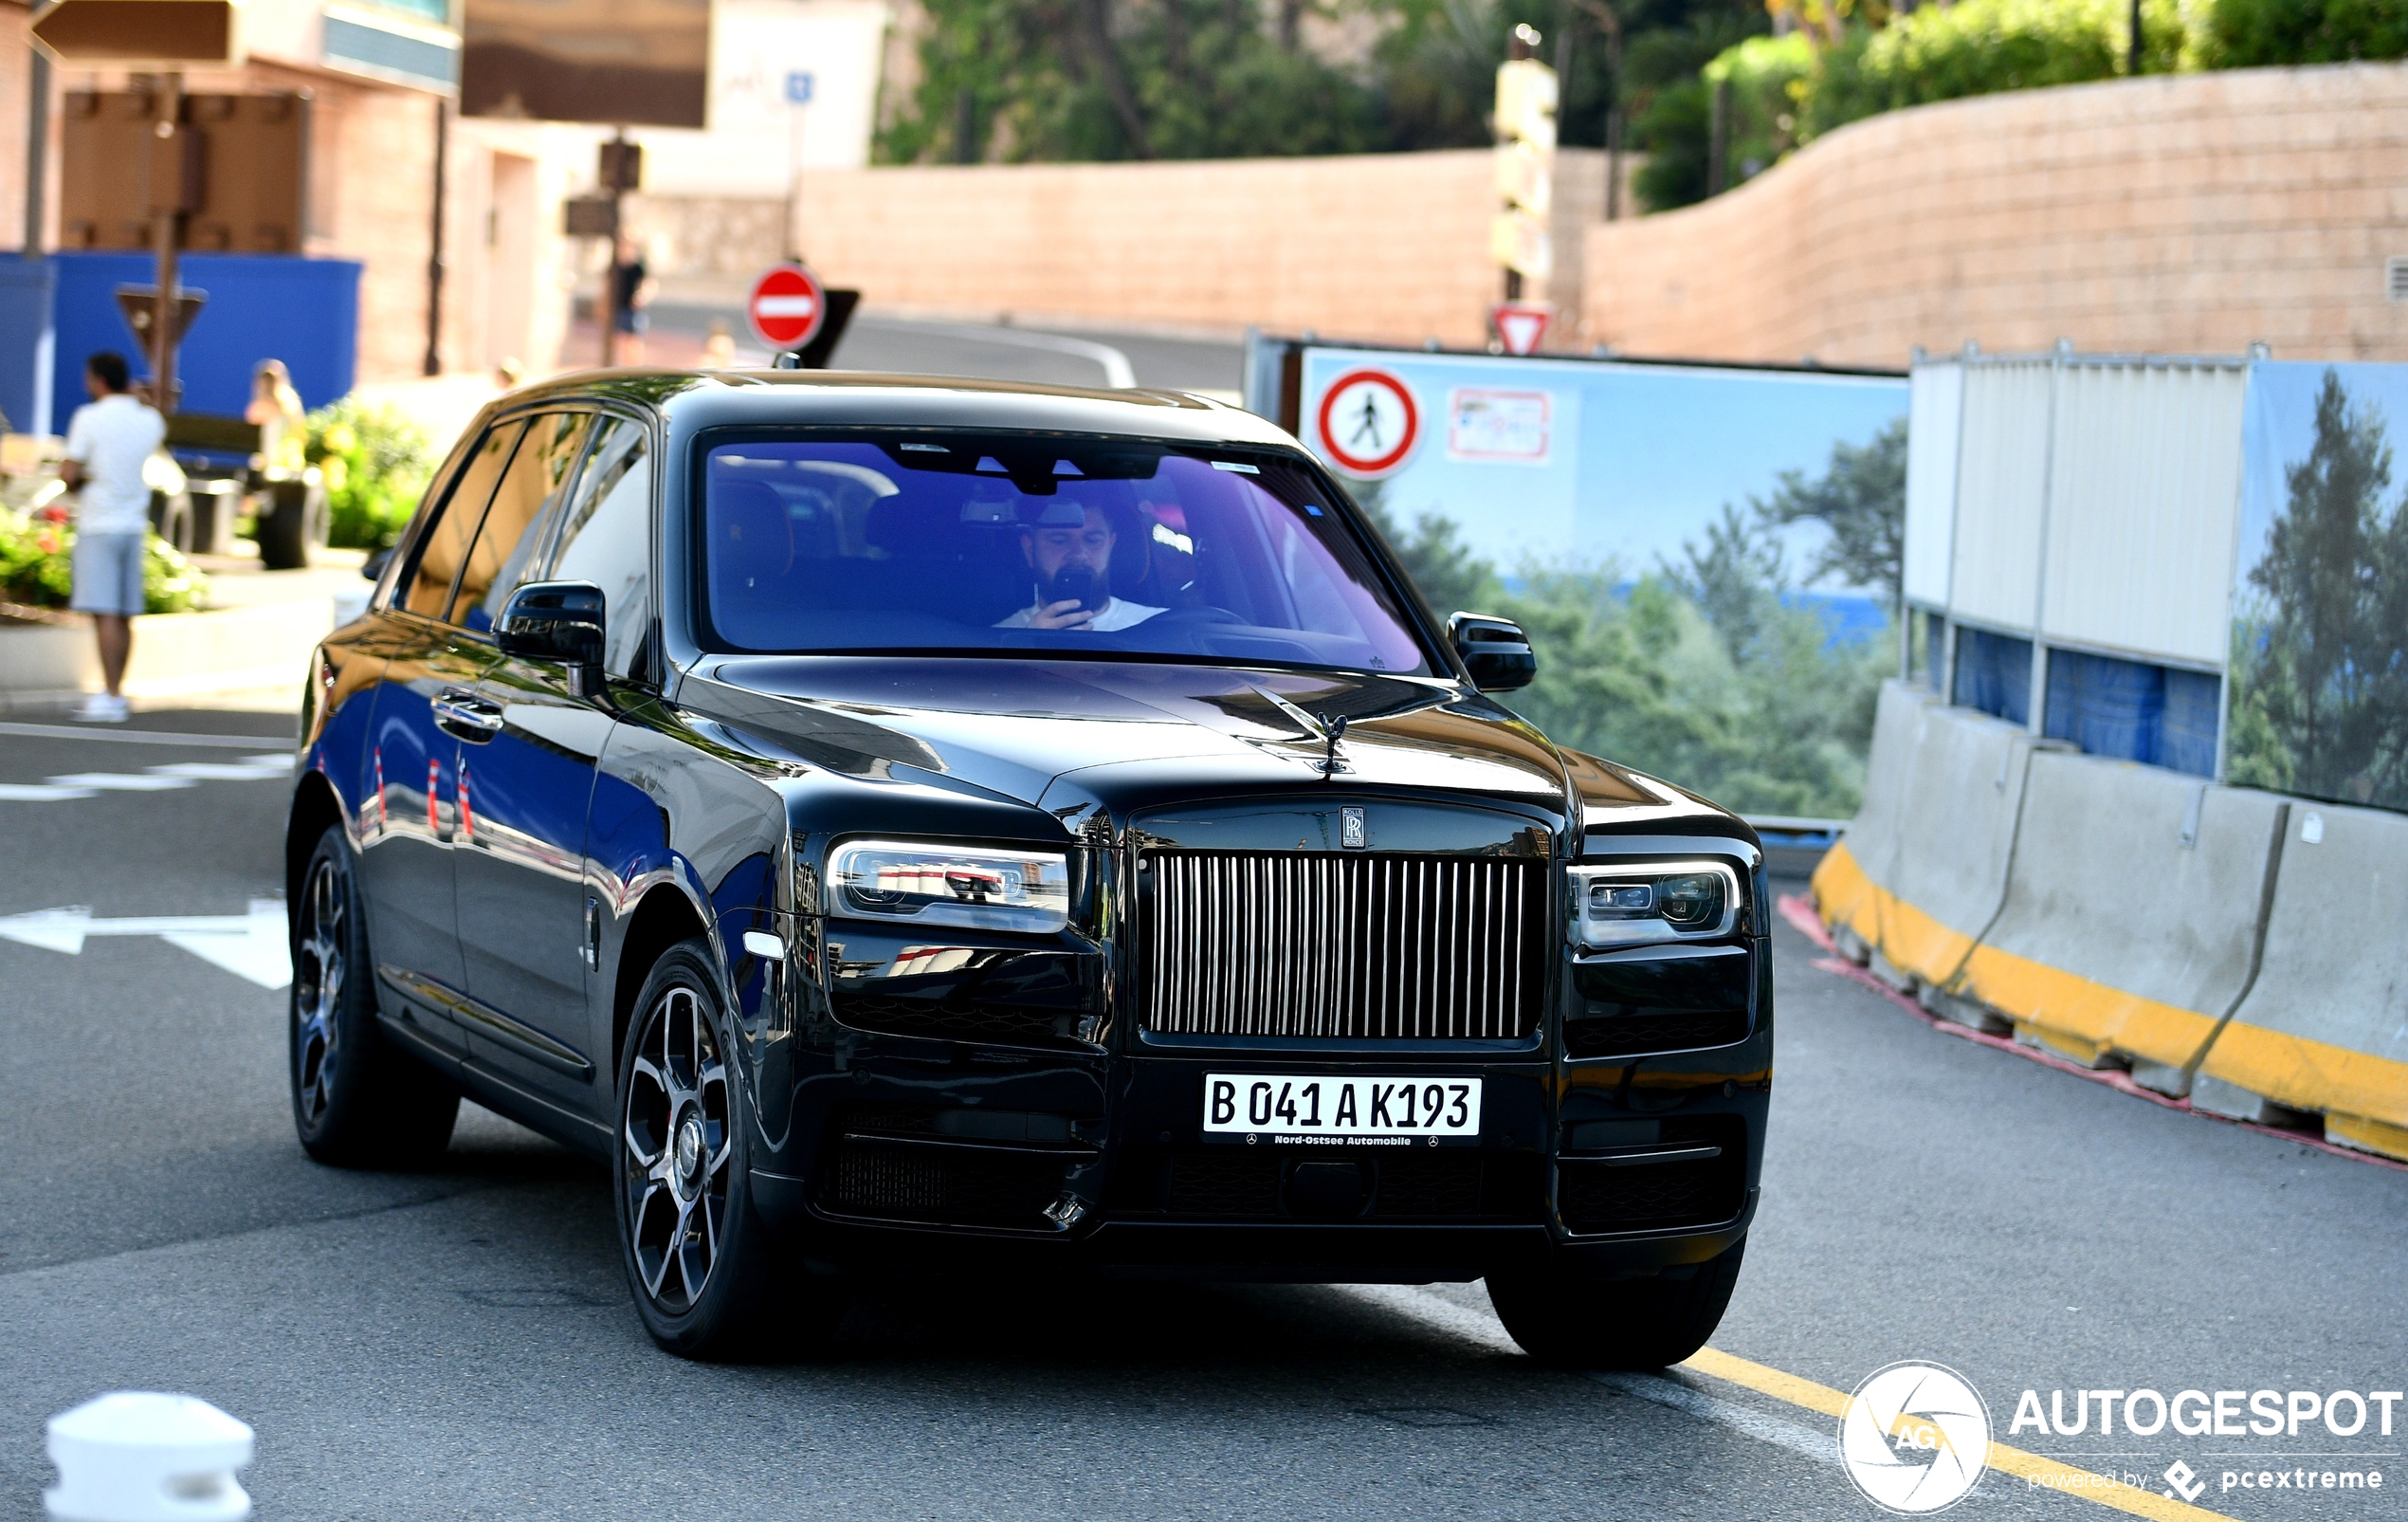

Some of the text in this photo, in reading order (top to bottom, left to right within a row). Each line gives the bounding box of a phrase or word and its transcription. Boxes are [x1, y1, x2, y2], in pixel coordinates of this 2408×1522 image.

[1212, 1080, 1236, 1125] B
[1274, 1135, 1412, 1146] Nord-Ostsee Automobile
